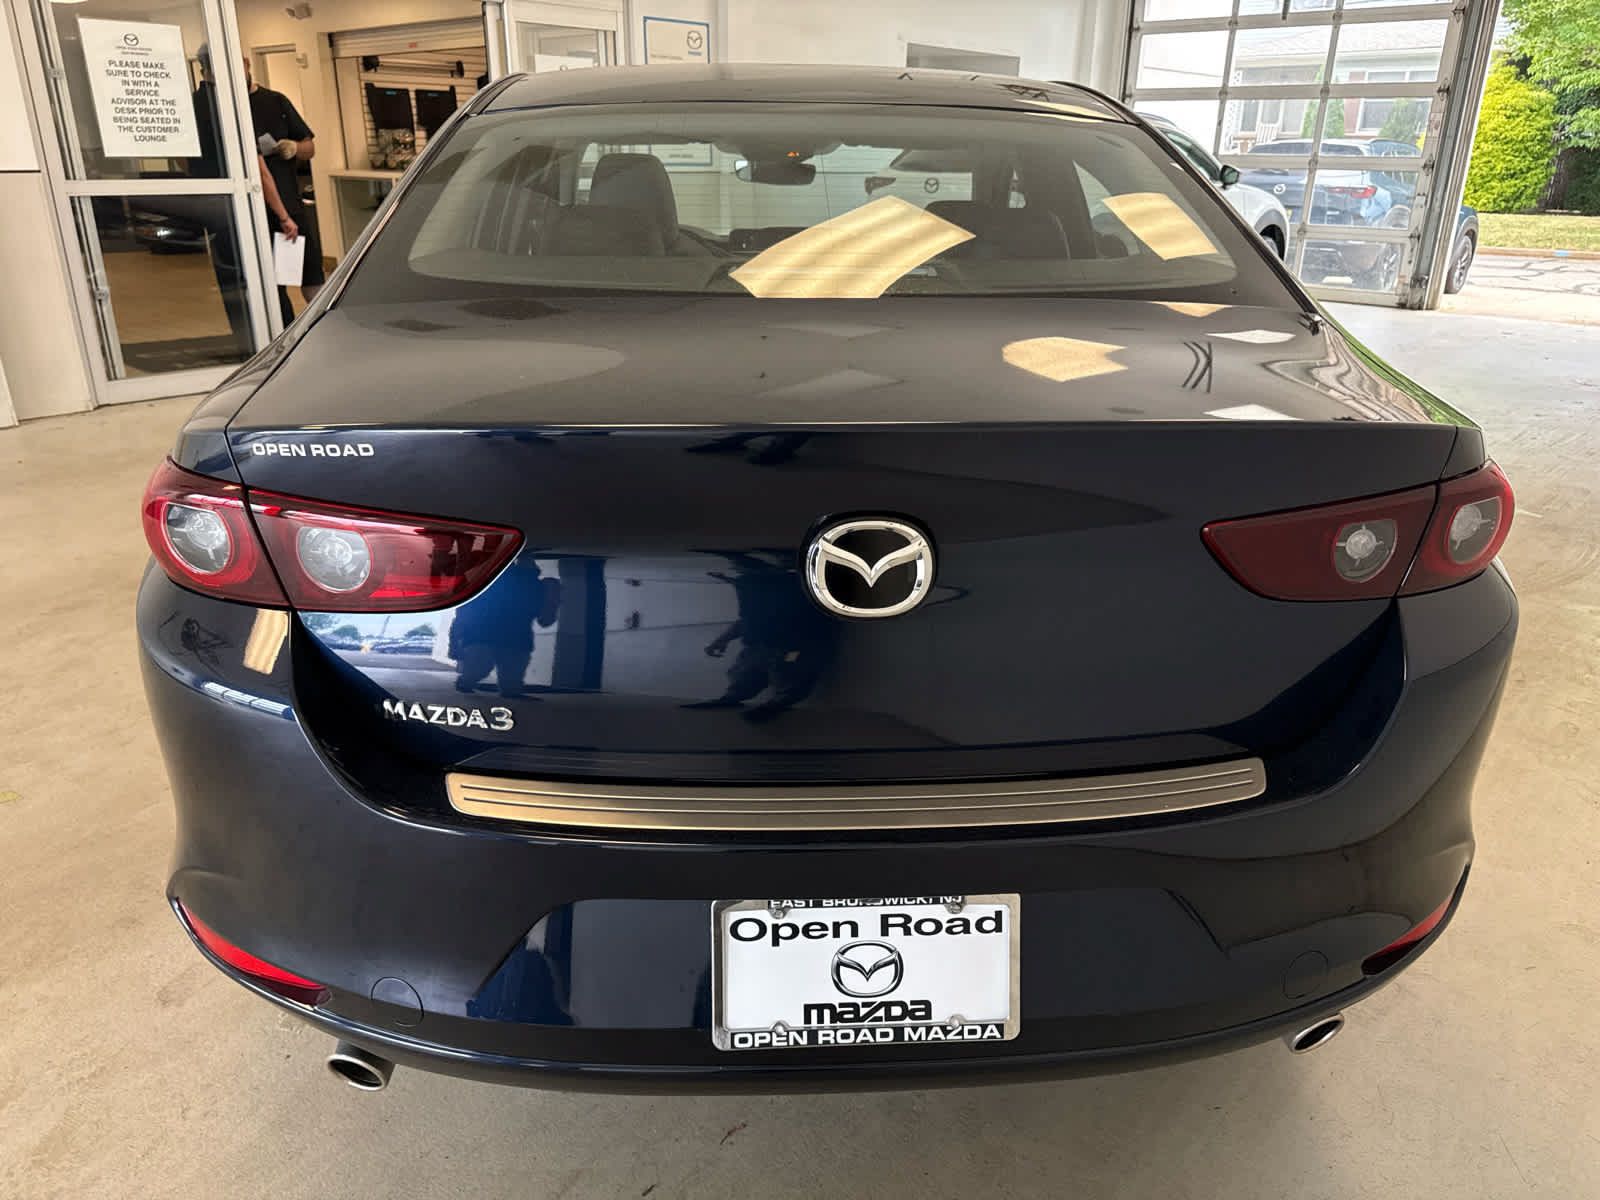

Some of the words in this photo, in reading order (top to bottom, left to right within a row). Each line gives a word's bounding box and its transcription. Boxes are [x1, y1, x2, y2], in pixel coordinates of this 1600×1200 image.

[108, 60, 141, 69] PLEASE
[142, 62, 166, 70] MAKE
[105, 69, 129, 77] SURE
[130, 70, 142, 78] TO
[143, 71, 171, 79] CHECK
[121, 79, 130, 87] IN
[131, 80, 153, 88] WITH
[125, 88, 160, 97] SERVICE
[161, 99, 177, 107] THE
[114, 106, 138, 114] DESK
[139, 107, 164, 115] PRIOR
[165, 108, 177, 116] TO
[112, 116, 138, 124] BEING
[140, 117, 172, 125] SEATED
[117, 125, 134, 133] THE
[135, 126, 180, 134] CUSTOMER
[252, 442, 306, 457] OPEN
[310, 443, 375, 458] ROAD
[729, 916, 859, 947] Open
[880, 910, 1004, 938] Road
[733, 1029, 809, 1049] OPEN
[817, 1027, 895, 1045] ROAD
[903, 1023, 1003, 1041] MAZDA
